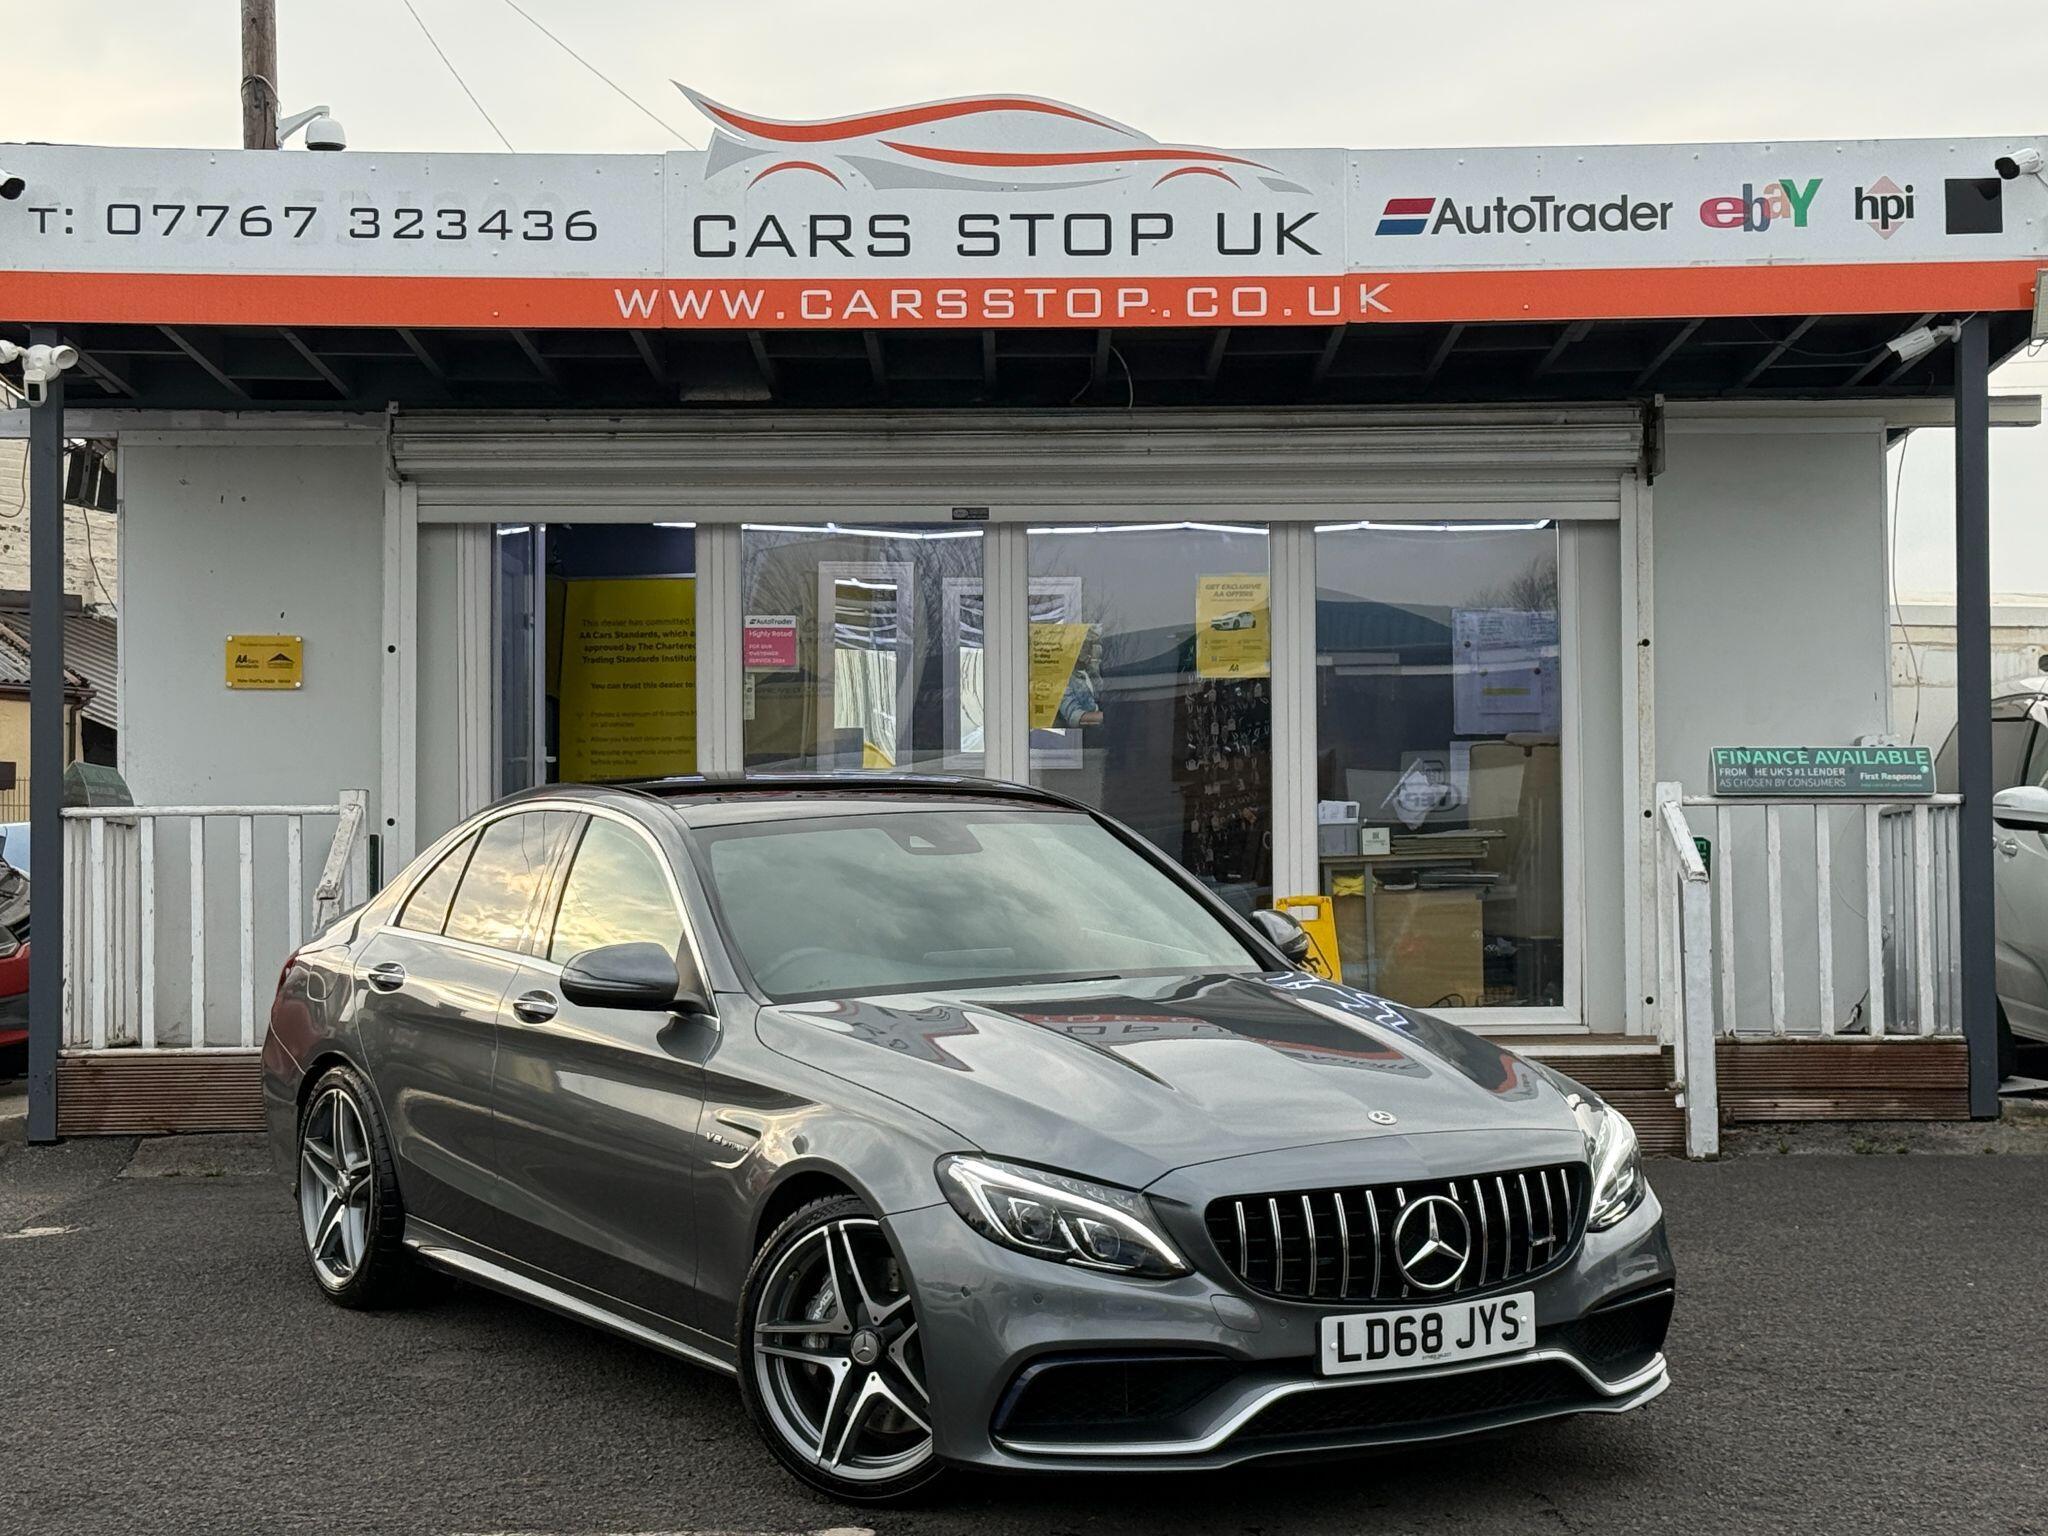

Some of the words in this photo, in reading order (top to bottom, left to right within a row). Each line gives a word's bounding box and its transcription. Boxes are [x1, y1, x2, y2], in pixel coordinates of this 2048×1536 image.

[1855, 185, 1914, 223] hpi
[1431, 195, 1673, 235] AutoTrader
[27, 207, 73, 235] T:
[107, 204, 317, 238] 07767
[349, 208, 597, 241] 323436
[692, 214, 911, 258] CARS
[956, 213, 1174, 257] STOP
[1216, 212, 1322, 256] UK
[645, 618, 690, 626] committed
[592, 631, 612, 639] Cars
[615, 630, 661, 639] Standards,
[662, 630, 688, 638] which
[584, 644, 624, 653] approved
[626, 643, 636, 652] by
[638, 642, 653, 650] The
[582, 656, 614, 665] Trading
[616, 655, 660, 664] Standards
[1717, 750, 1809, 765] FINANCE
[1815, 750, 1929, 765] AVAILABLE
[1719, 767, 1747, 777] FROM
[1751, 767, 1768, 777] HE
[1769, 767, 1793, 776] UK'S
[1807, 767, 1846, 776] LENDER
[1860, 772, 1879, 781] First
[1881, 772, 1923, 782] Response
[1719, 778, 1731, 788] AS
[1733, 778, 1773, 788] CHOSEN
[1774, 778, 1787, 788] BY
[1787, 777, 1847, 787] CONSUMERS
[1337, 1312, 1444, 1363] LD68
[1455, 1300, 1520, 1349] JYS
